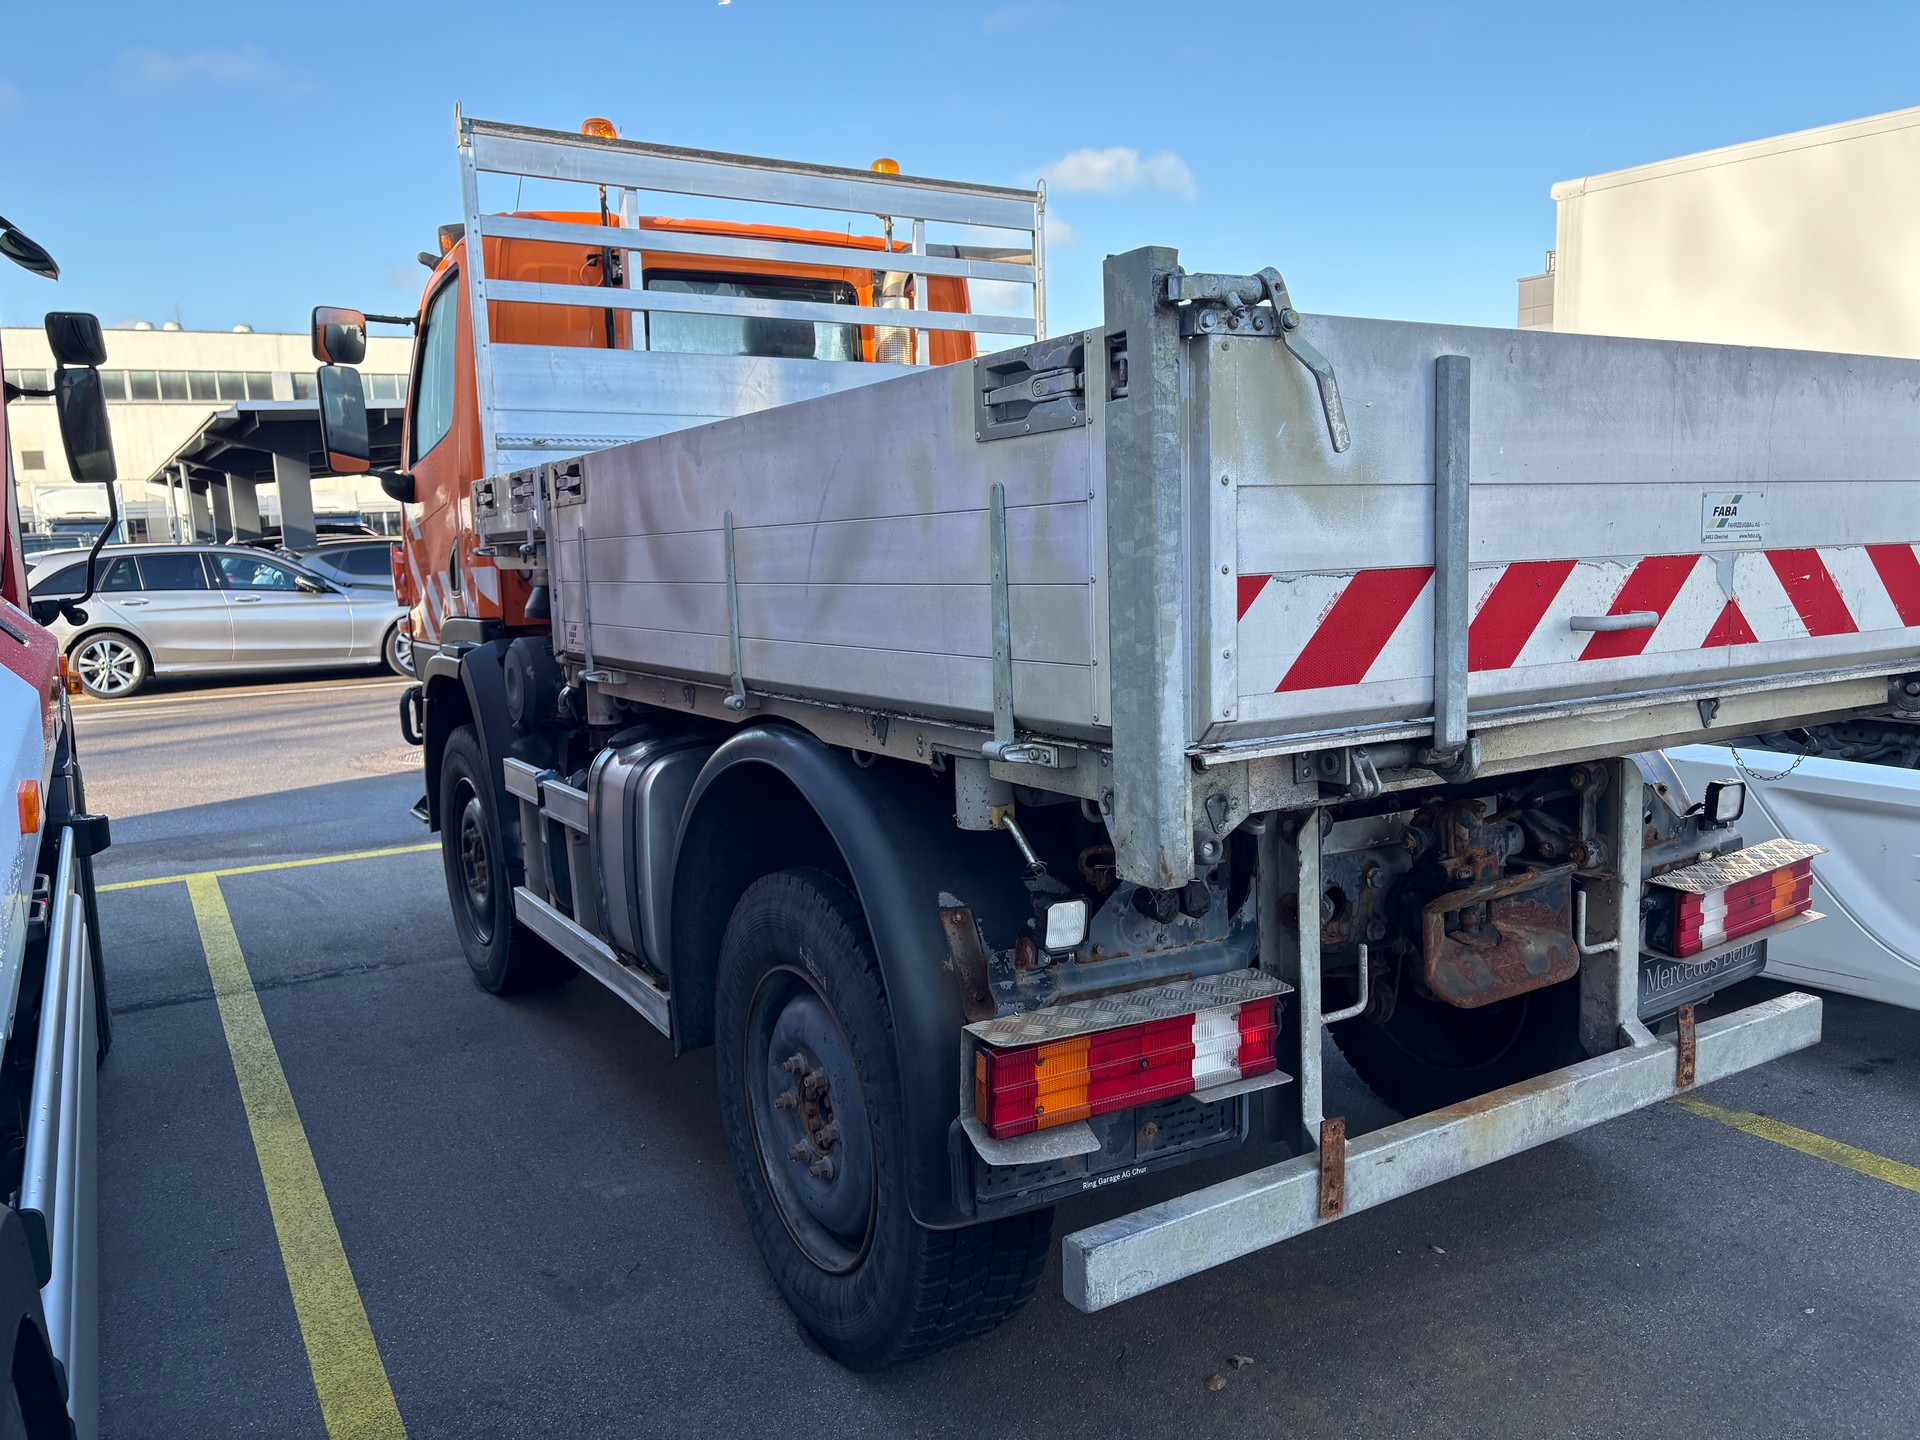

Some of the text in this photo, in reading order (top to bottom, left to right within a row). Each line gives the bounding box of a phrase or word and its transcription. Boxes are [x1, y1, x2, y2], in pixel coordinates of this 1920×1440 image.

[1713, 506, 1737, 516] FABA
[1082, 1166, 1147, 1189] Ring Garage AG Chur
